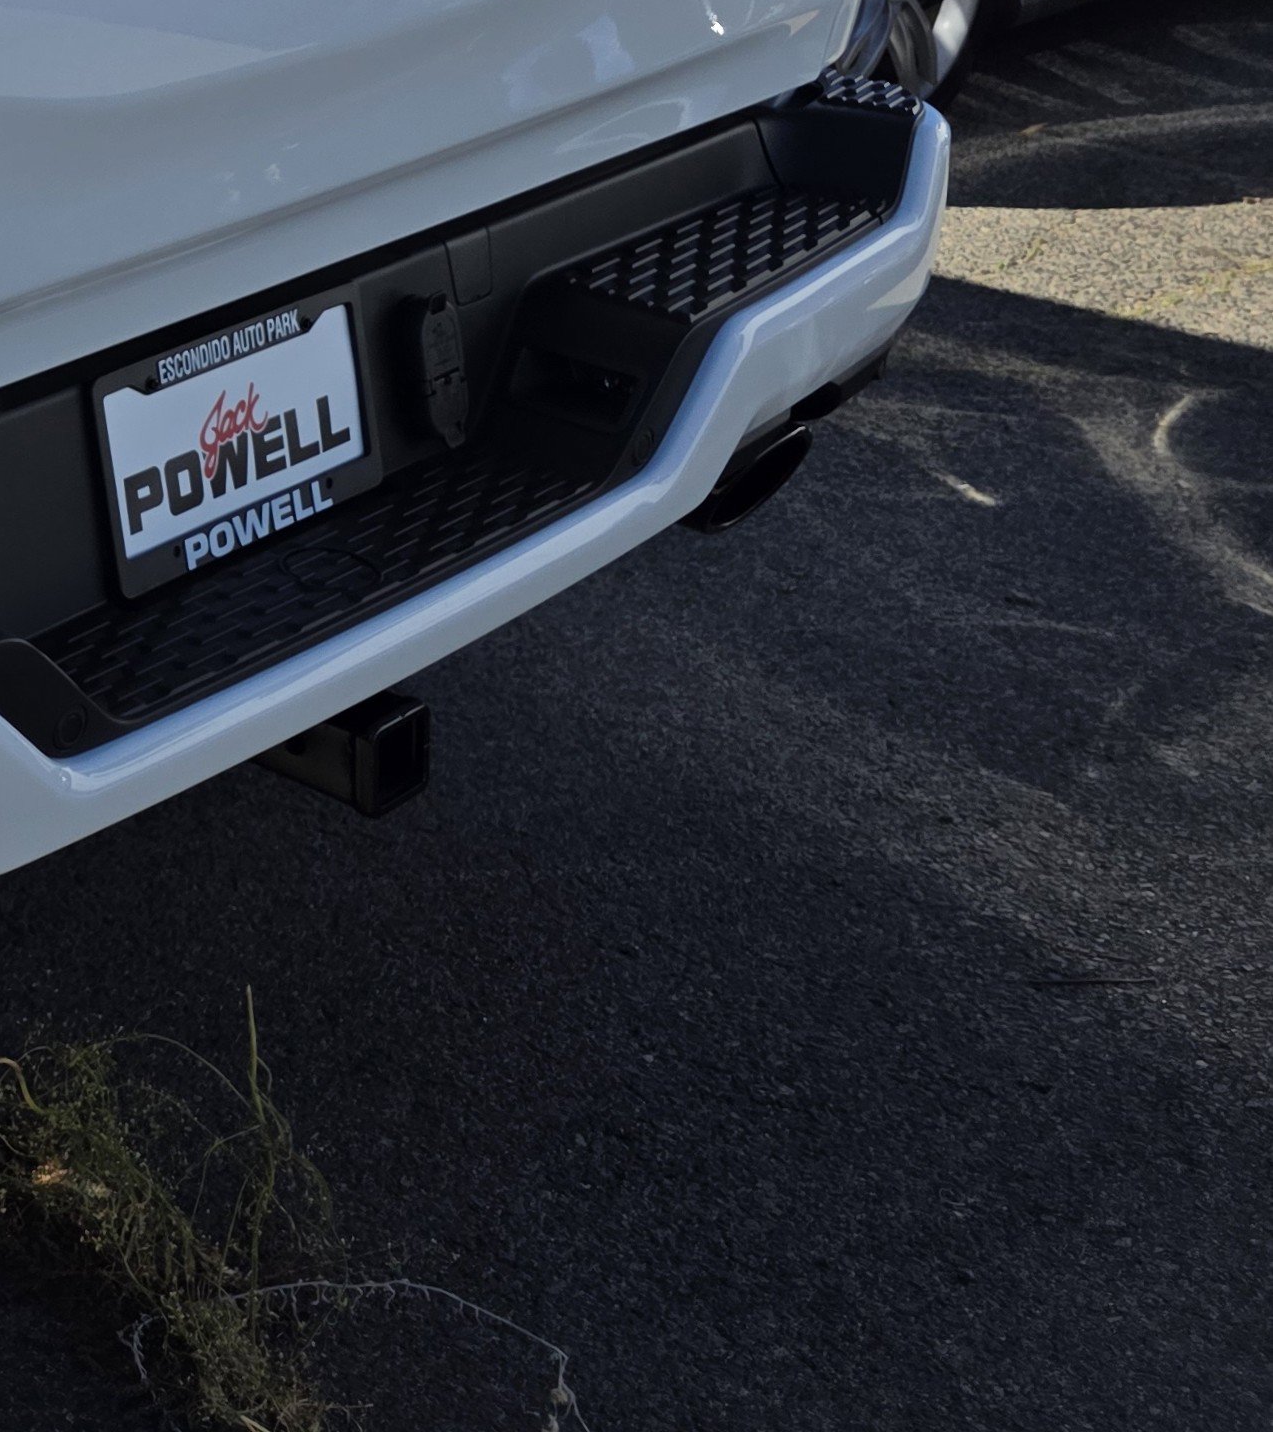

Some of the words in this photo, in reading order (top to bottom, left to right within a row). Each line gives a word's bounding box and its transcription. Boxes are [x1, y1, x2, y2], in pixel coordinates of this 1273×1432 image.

[158, 334, 230, 385] ESCONDIDO
[232, 321, 266, 353] AUTO
[266, 308, 301, 342] PARK
[123, 394, 351, 536] POWELL
[199, 381, 269, 480] Jack
[184, 480, 334, 572] POWELL
